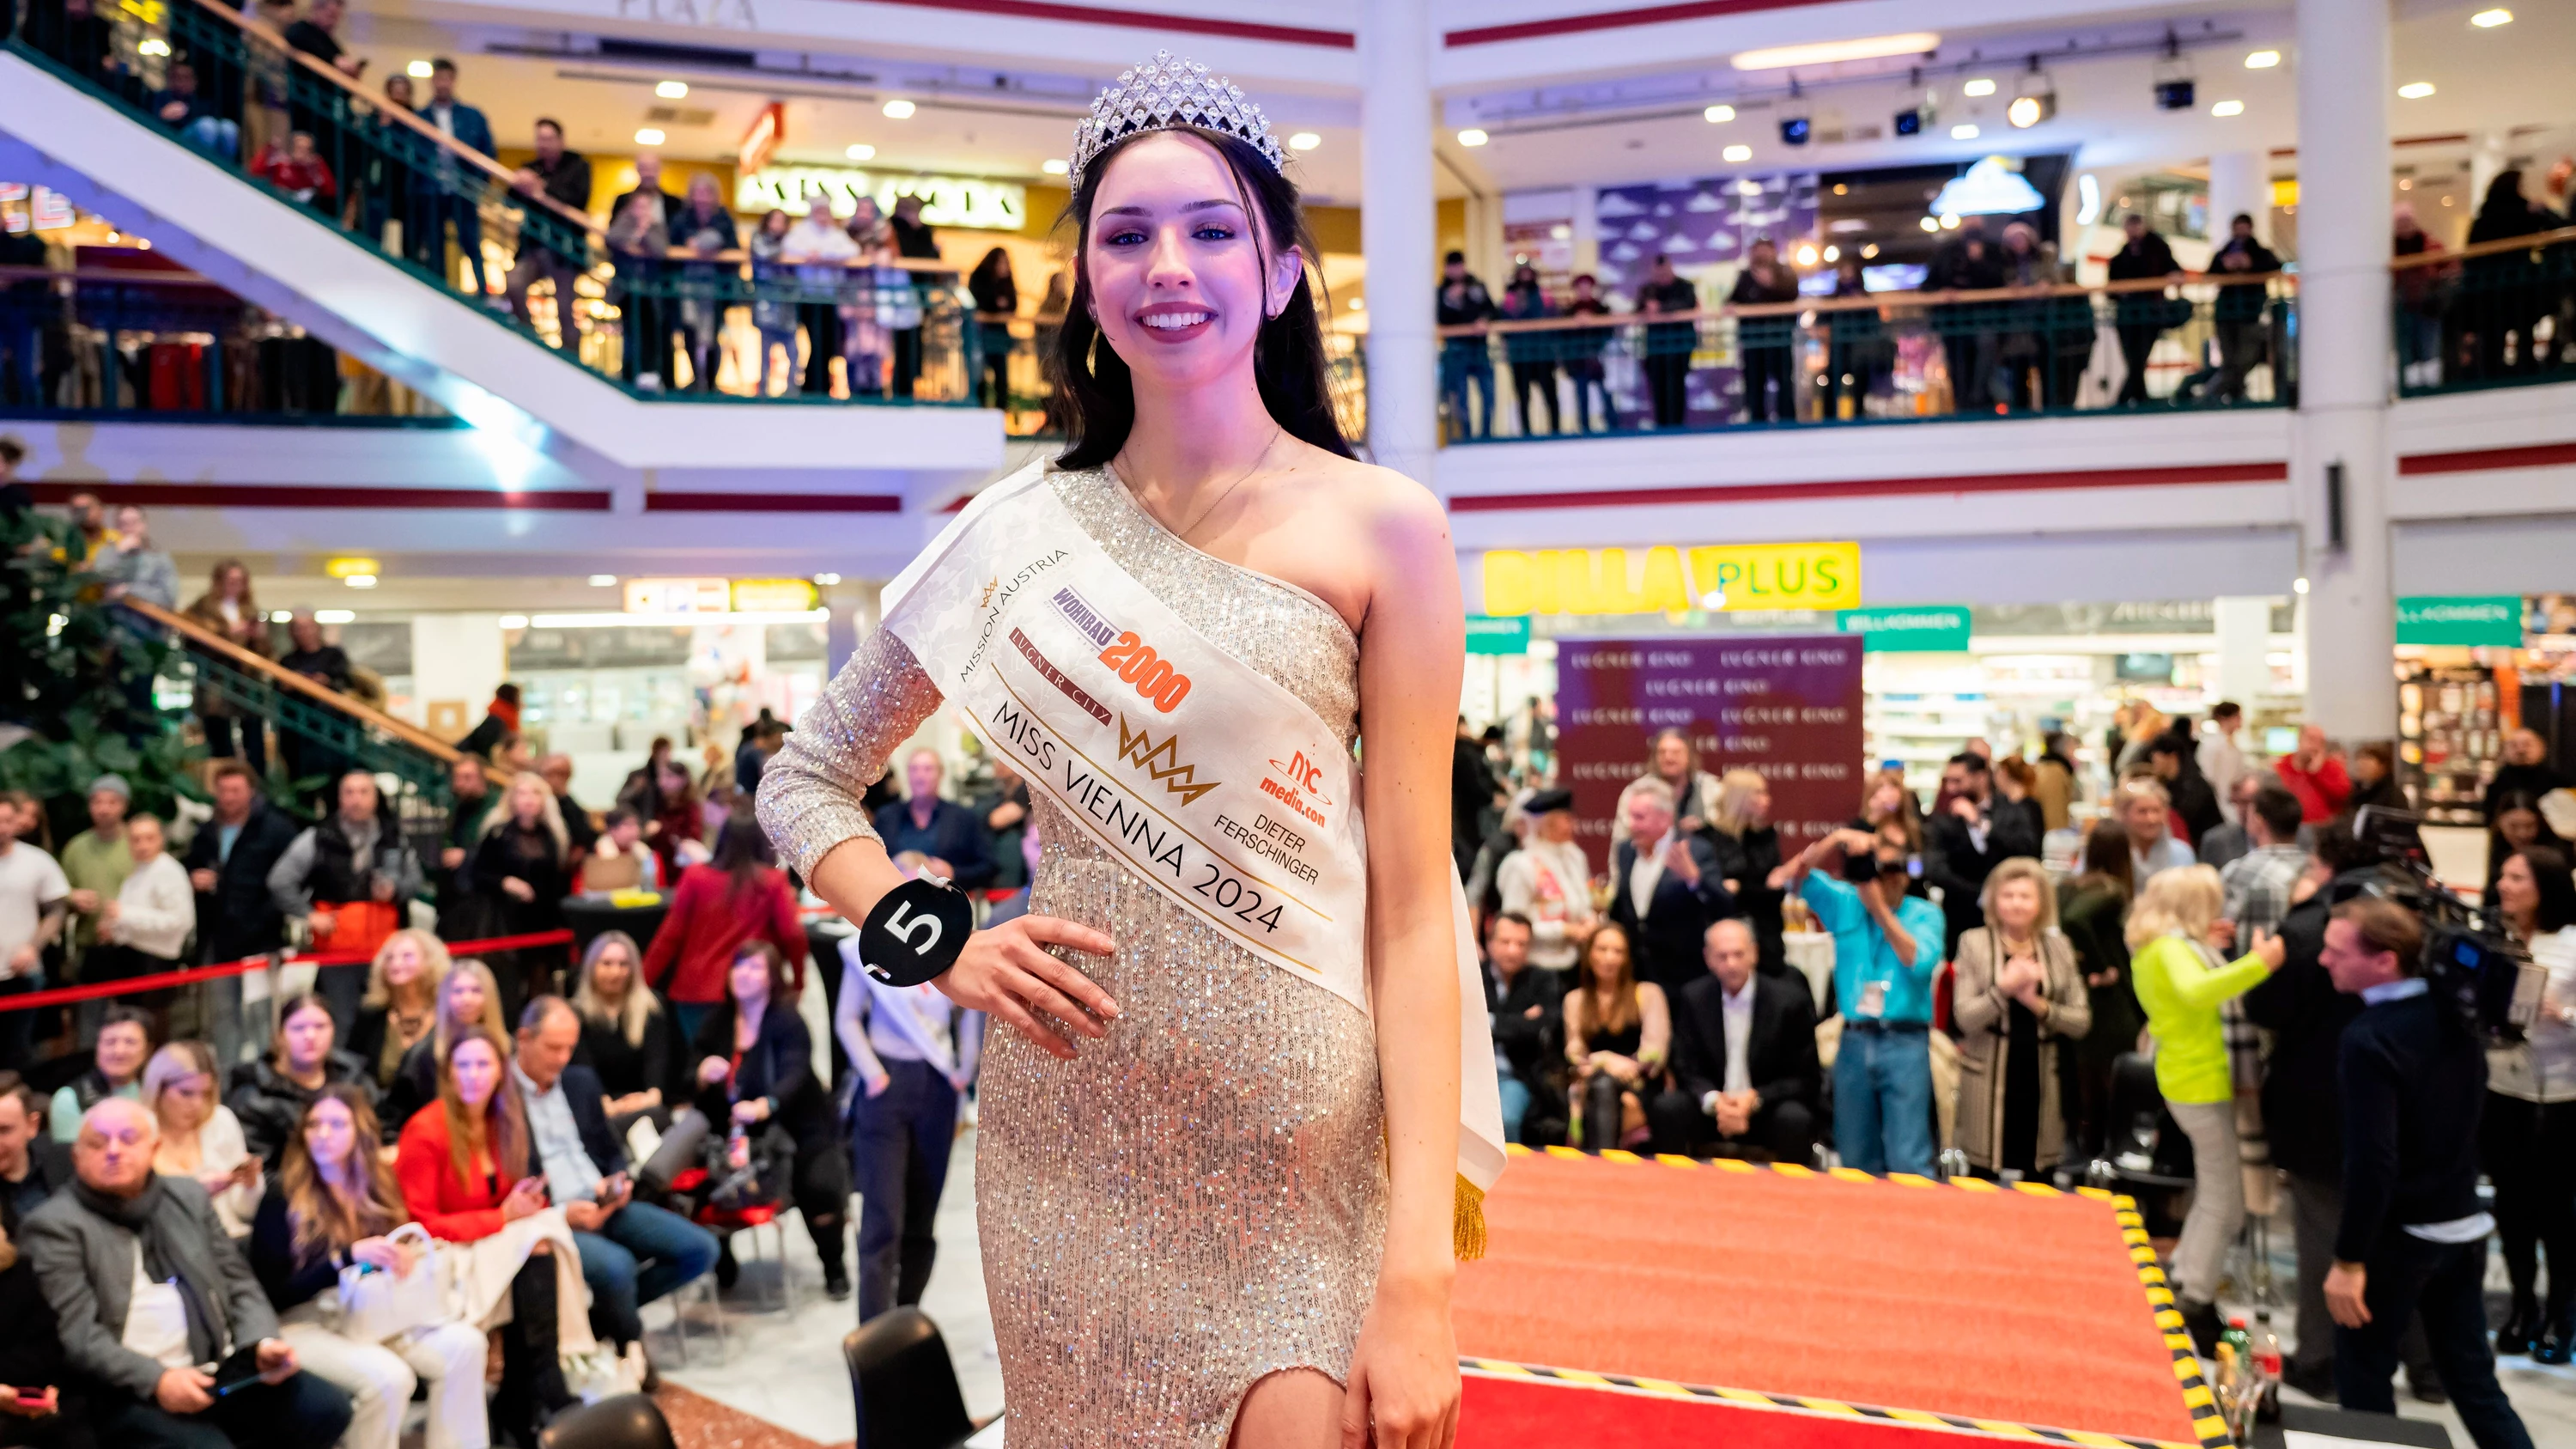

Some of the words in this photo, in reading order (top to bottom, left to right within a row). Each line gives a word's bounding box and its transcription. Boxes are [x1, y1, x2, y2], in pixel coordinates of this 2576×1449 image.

[960, 606, 1000, 683] MISSION
[999, 549, 1069, 606] AUSTRIA
[1717, 559, 1838, 595] PLUS
[1011, 630, 1066, 689] LUGNER
[1072, 689, 1109, 720] CITY
[1052, 587, 1115, 647] WOHNBAU
[1097, 630, 1192, 714] 2000
[992, 700, 1056, 770] MISS
[1066, 759, 1184, 878] VIENNA
[1192, 863, 1285, 934] 2024
[1213, 814, 1319, 886] FERSCHINGER
[1253, 813, 1306, 853] DIETER
[884, 899, 943, 956] 5
